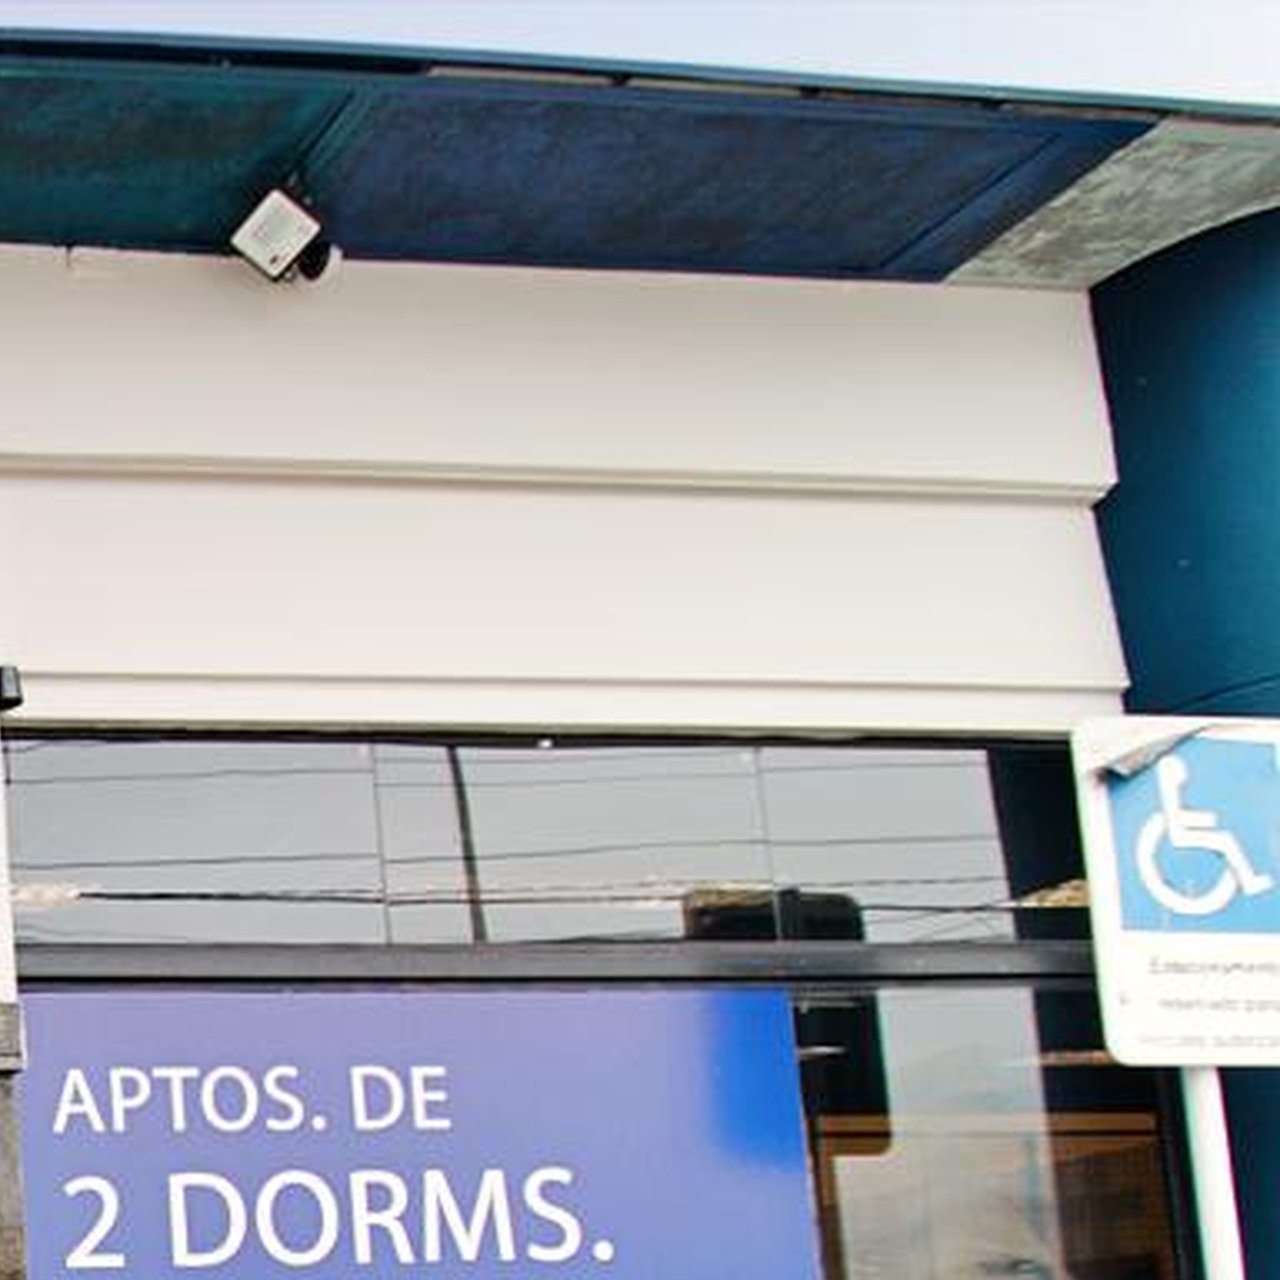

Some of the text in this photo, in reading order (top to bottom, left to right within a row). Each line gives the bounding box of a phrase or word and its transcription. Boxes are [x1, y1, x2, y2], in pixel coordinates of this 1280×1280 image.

[52, 1065, 451, 1133] APTOS. DE
[63, 1167, 614, 1268] 2 DORMS.
